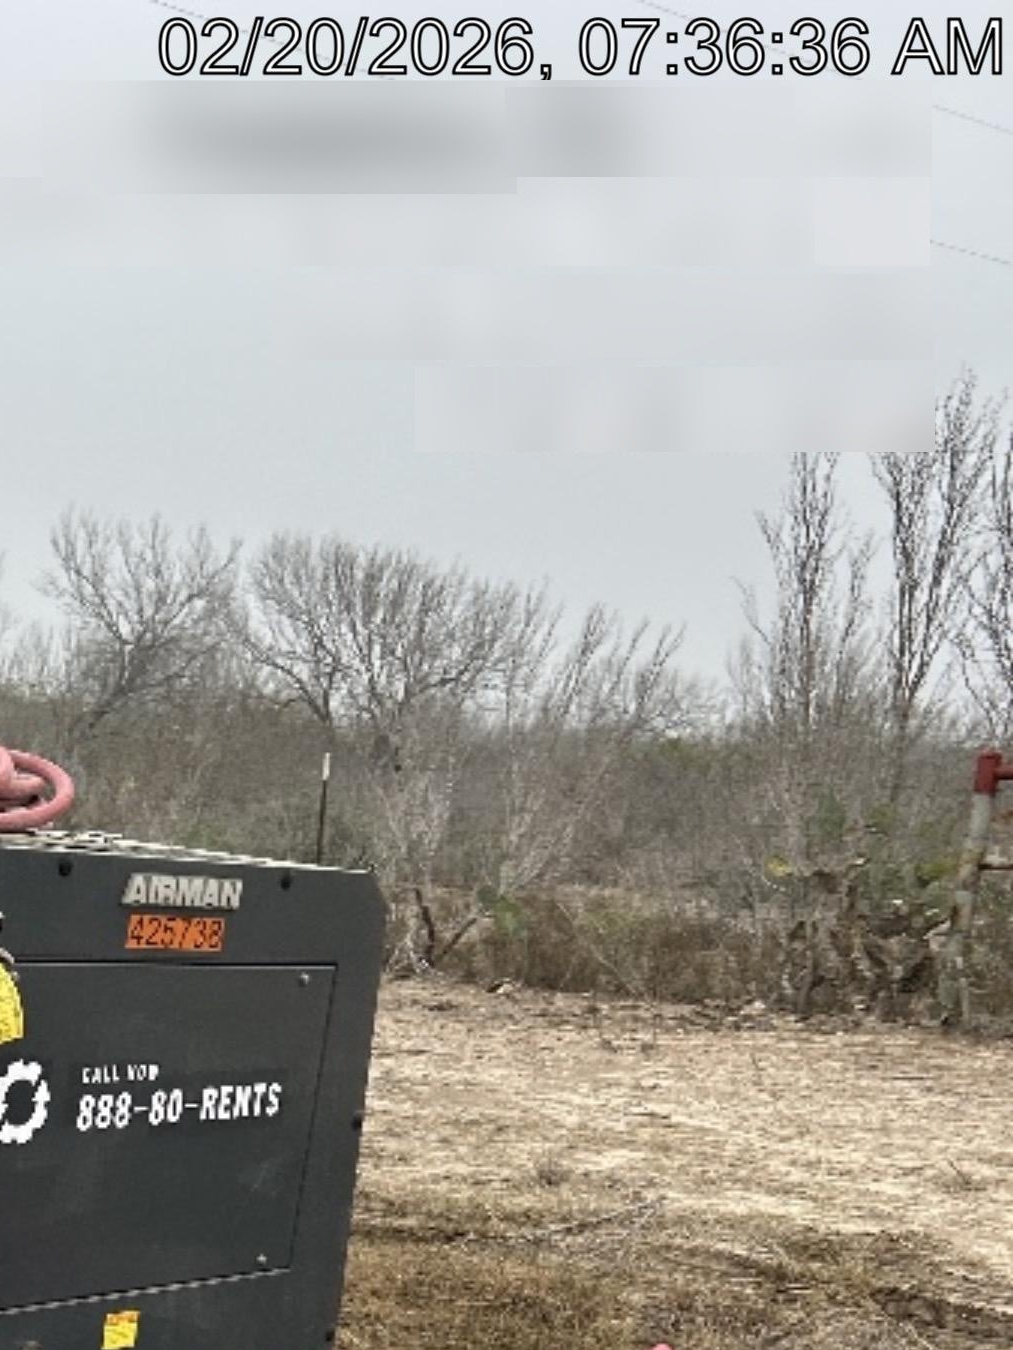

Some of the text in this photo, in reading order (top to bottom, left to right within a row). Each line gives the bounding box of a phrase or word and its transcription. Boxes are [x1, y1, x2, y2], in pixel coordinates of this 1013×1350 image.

[121, 872, 243, 910] AIRMAN
[130, 917, 224, 949] 425738
[82, 1066, 120, 1084] CALL
[76, 1082, 283, 1132] 888-80-RENTS
